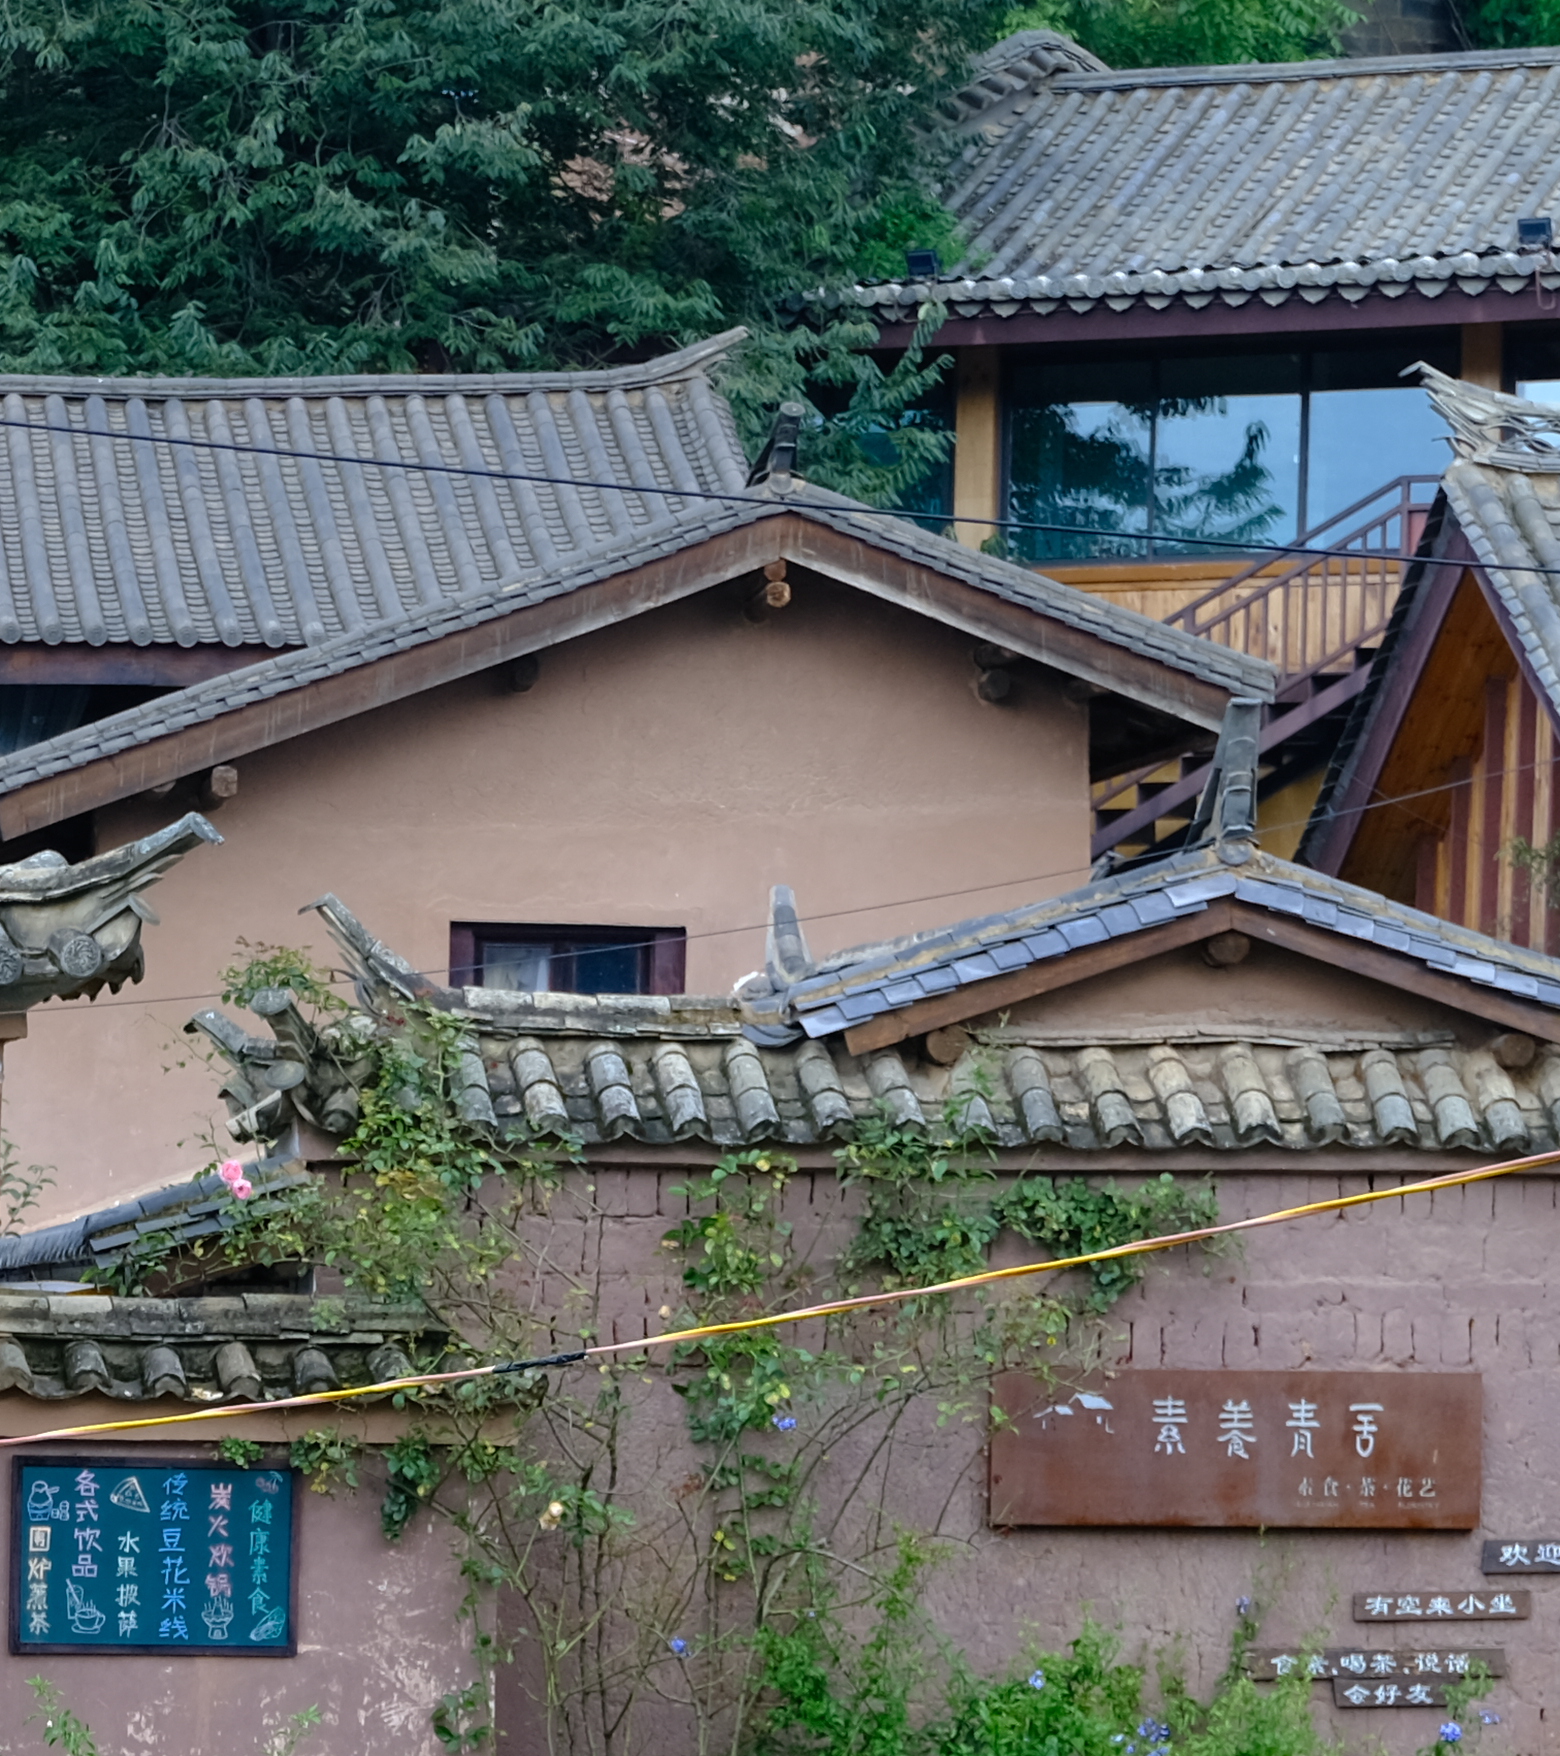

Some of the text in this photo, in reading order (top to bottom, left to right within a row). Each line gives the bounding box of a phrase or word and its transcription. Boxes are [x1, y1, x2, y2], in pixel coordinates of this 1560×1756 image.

[71, 1469, 103, 1578] 各式饮品
[158, 1472, 190, 1641] 传统豆花米线
[247, 1499, 273, 1616] 健康素食
[115, 1530, 141, 1638] 水果披萨
[1364, 1594, 1517, 1616] 有空来小坐
[1343, 1683, 1433, 1705] 会好友
